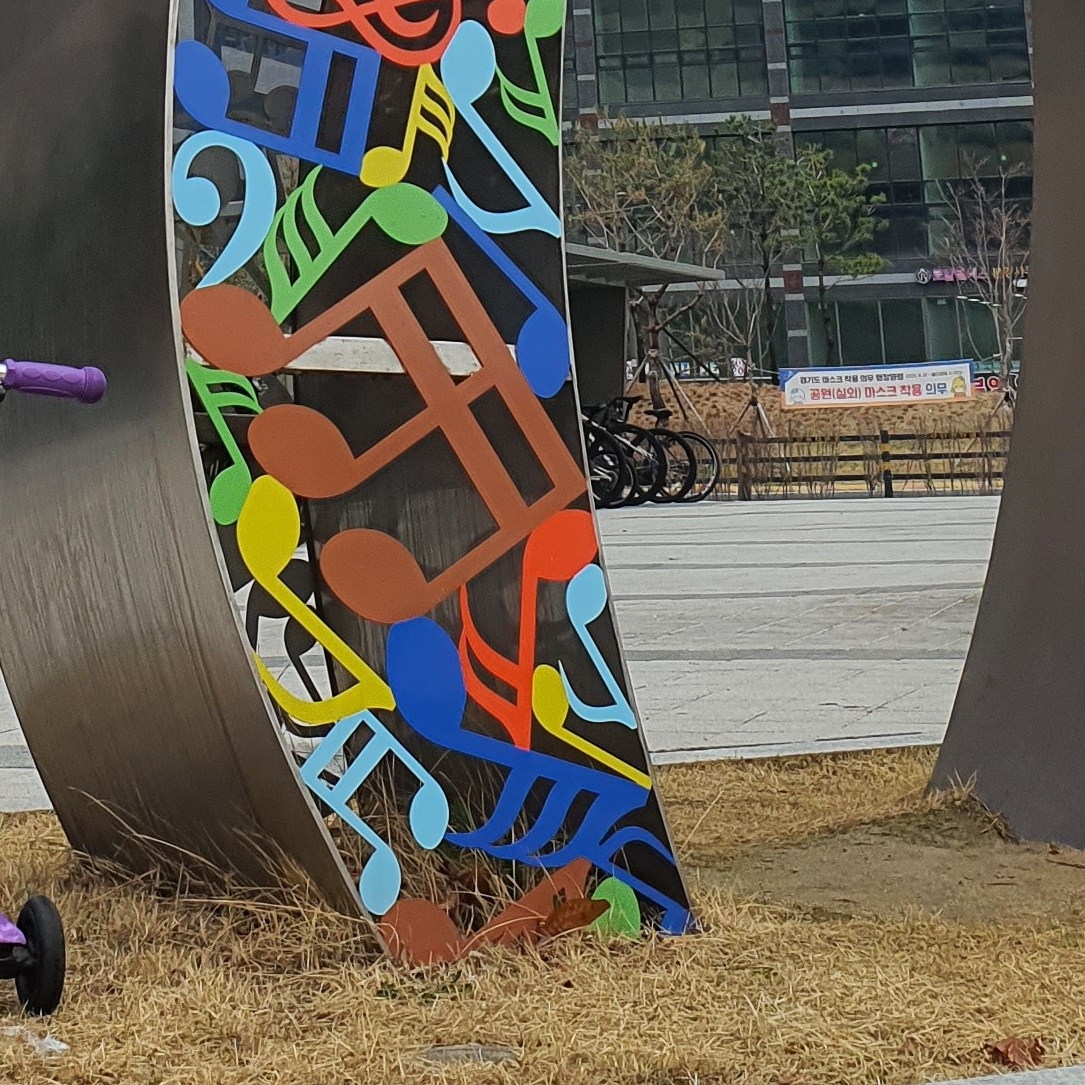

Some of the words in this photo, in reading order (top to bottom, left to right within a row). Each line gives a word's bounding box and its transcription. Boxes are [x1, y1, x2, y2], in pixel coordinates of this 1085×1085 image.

[809, 386, 862, 401] 공원(실외)
[864, 385, 897, 399] 마스크
[900, 383, 922, 397] 착용
[925, 382, 947, 396] 의무
